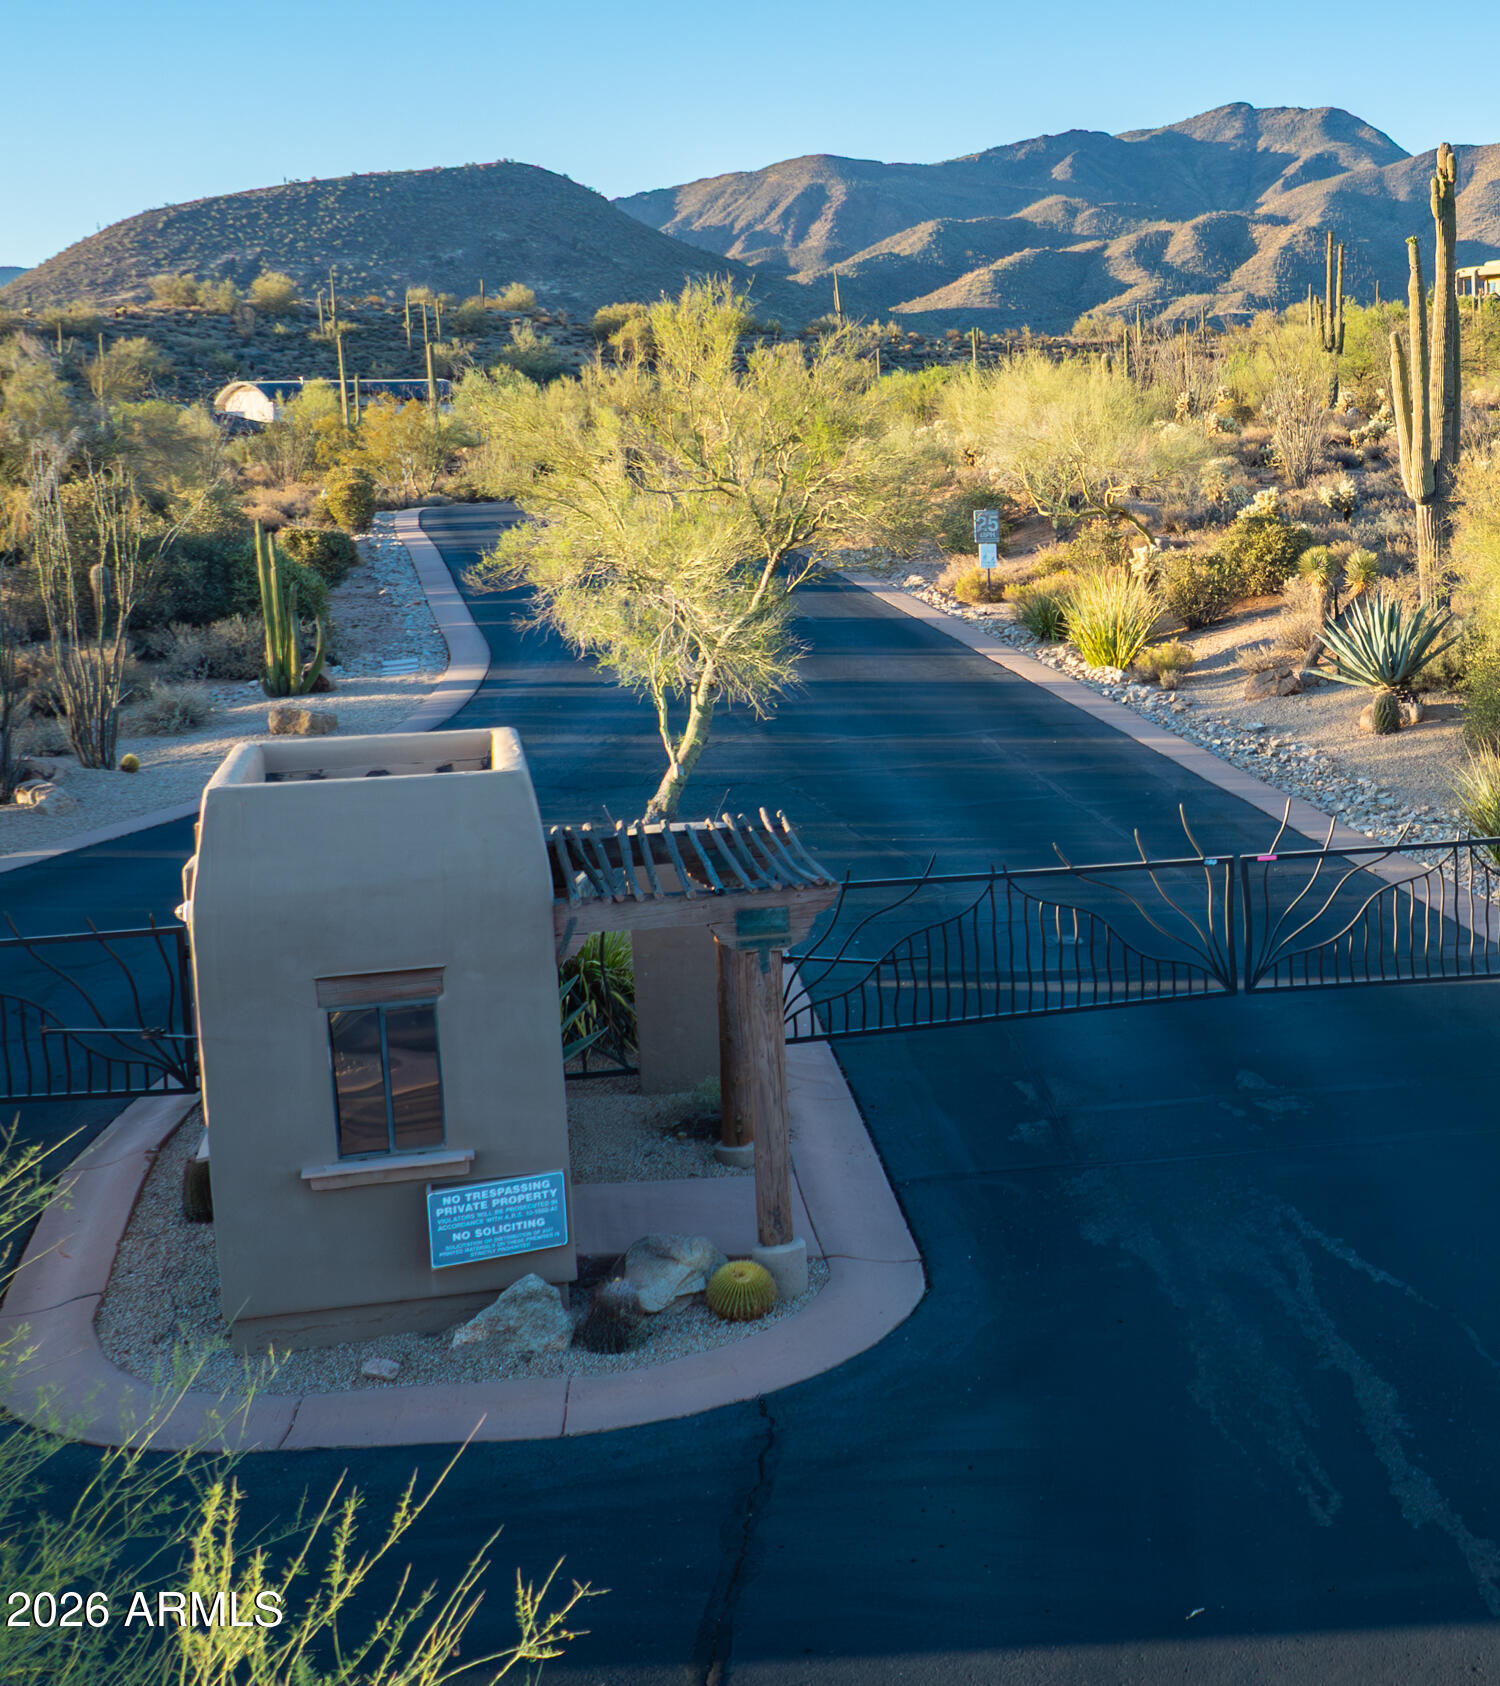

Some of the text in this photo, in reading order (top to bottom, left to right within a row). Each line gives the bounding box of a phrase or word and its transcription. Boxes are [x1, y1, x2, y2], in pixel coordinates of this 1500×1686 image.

[976, 515, 999, 532] 25
[436, 1189, 557, 1217] PRIVATE PROPERTY
[443, 1180, 550, 1205] NO TRESPASSING
[452, 1218, 545, 1241] NO SOLICITING
